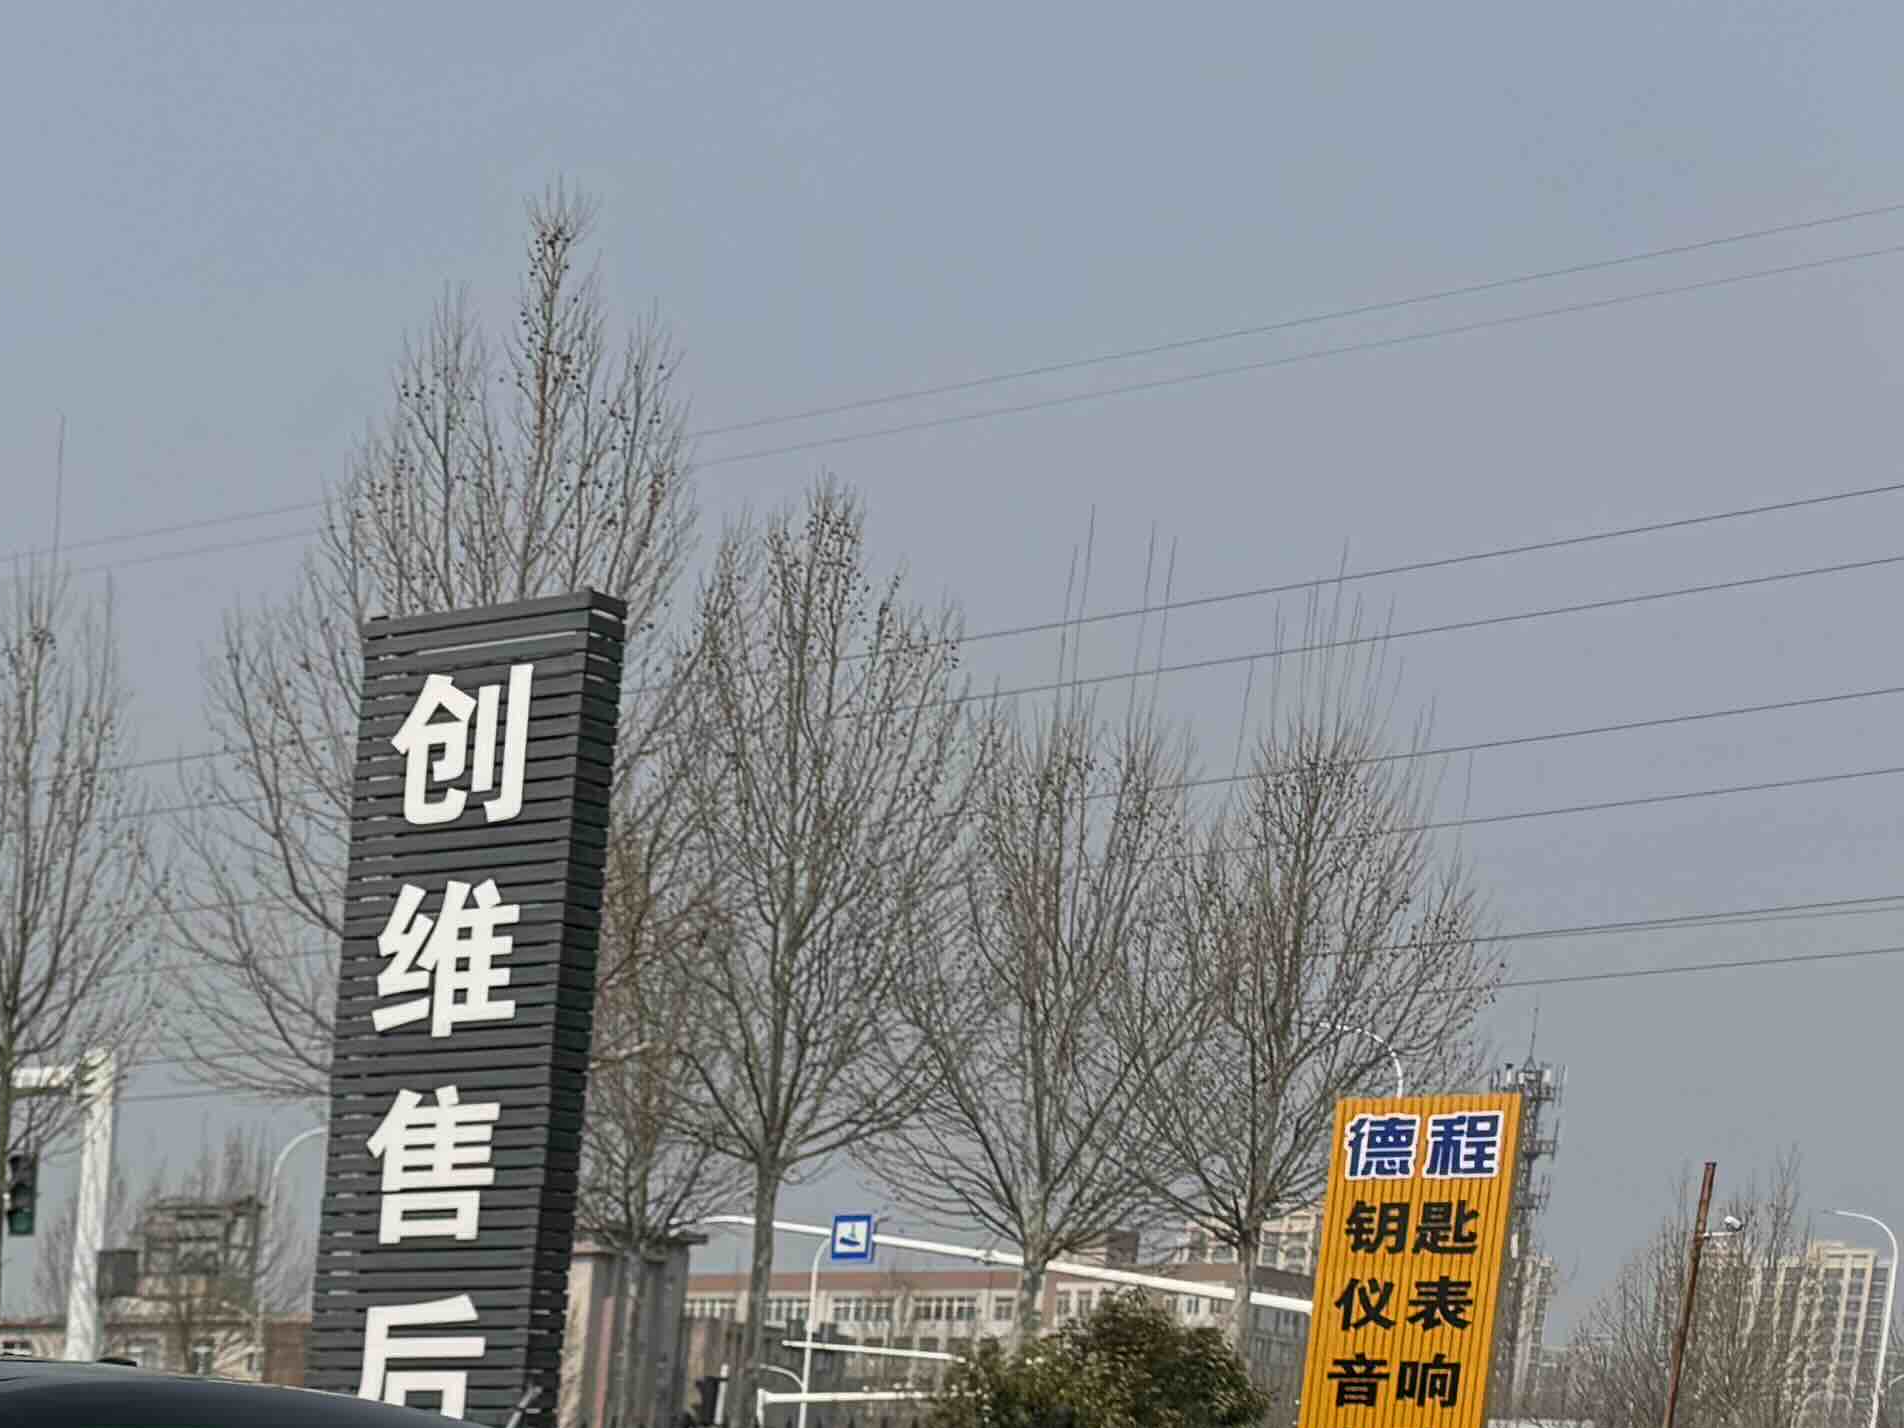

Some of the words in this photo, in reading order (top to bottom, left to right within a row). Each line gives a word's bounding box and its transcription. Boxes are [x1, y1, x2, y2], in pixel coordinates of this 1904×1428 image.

[359, 662, 534, 1421] 创维售后
[1345, 1112, 1504, 1180] 德程
[1345, 1199, 1481, 1255] 钥匙
[1334, 1276, 1474, 1331] 仪表
[1327, 1352, 1462, 1408] 音响
